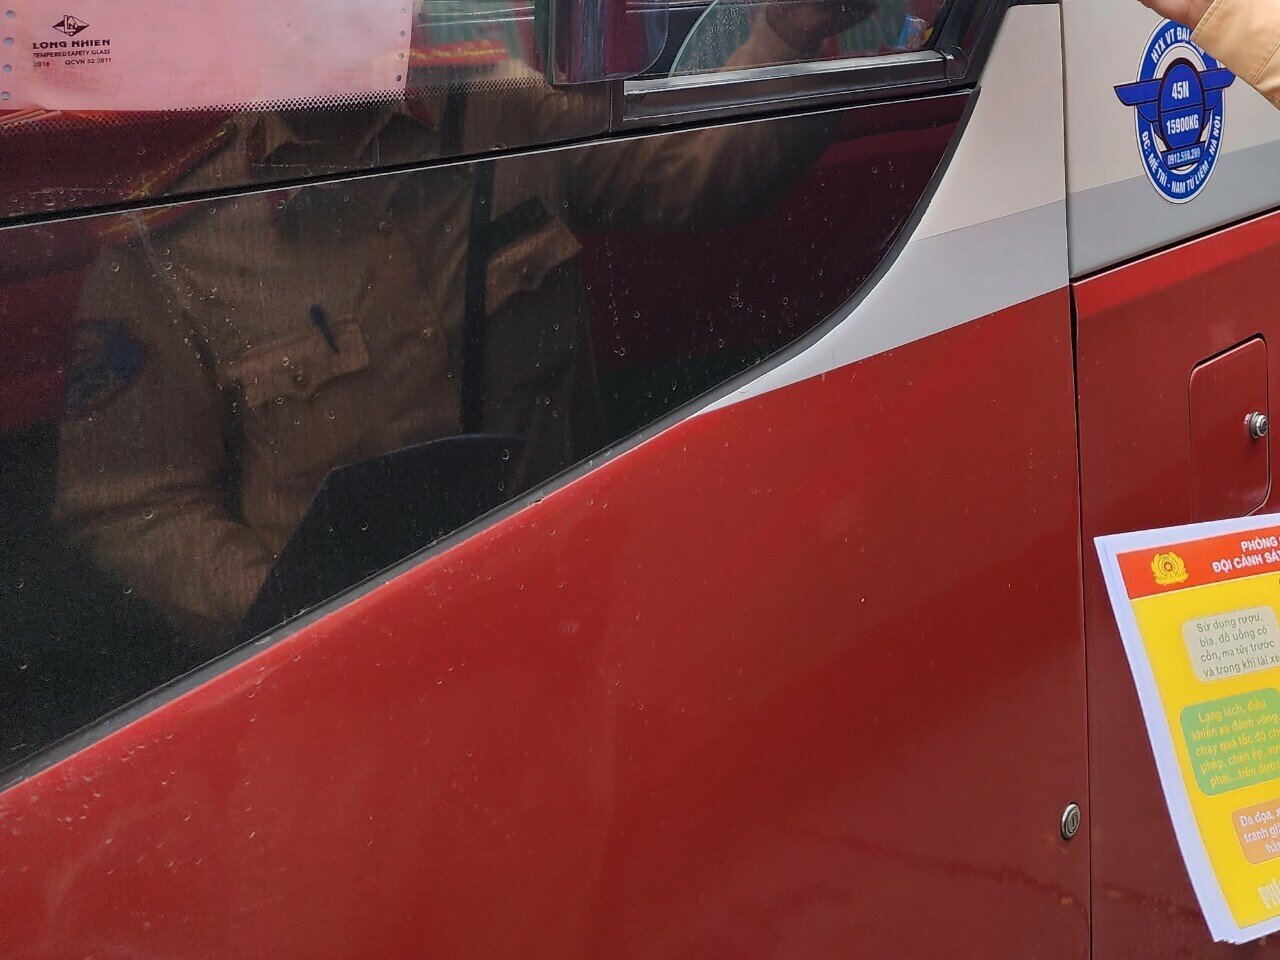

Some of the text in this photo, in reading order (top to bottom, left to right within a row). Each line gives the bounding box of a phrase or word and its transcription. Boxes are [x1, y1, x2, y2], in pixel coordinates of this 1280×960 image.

[33, 39, 110, 49] LONG NHIEN
[1151, 37, 1165, 63] HTX
[1165, 28, 1175, 44] VT
[1172, 80, 1189, 99] 45N
[1166, 114, 1199, 134] 15900KG
[1172, 181, 1185, 194] NAM
[1187, 175, 1194, 191] TỪ
[1194, 160, 1210, 185] LIÊM
[1213, 115, 1221, 138] NỘI
[1240, 535, 1278, 552] PHÒNG
[1212, 558, 1233, 573] ĐỘI
[1234, 552, 1263, 569] CẢNH
[1197, 622, 1210, 633] Sử
[1213, 619, 1236, 630] dụng
[1218, 632, 1230, 644] đồ
[1232, 628, 1256, 641] uống
[1257, 627, 1268, 636] có
[1222, 649, 1234, 658] ma
[1236, 644, 1249, 656] túy
[1250, 639, 1275, 652] trước
[1203, 654, 1280, 678] và trong khi lái xe
[1240, 815, 1253, 827] Đe
[1244, 828, 1268, 843] tranh
